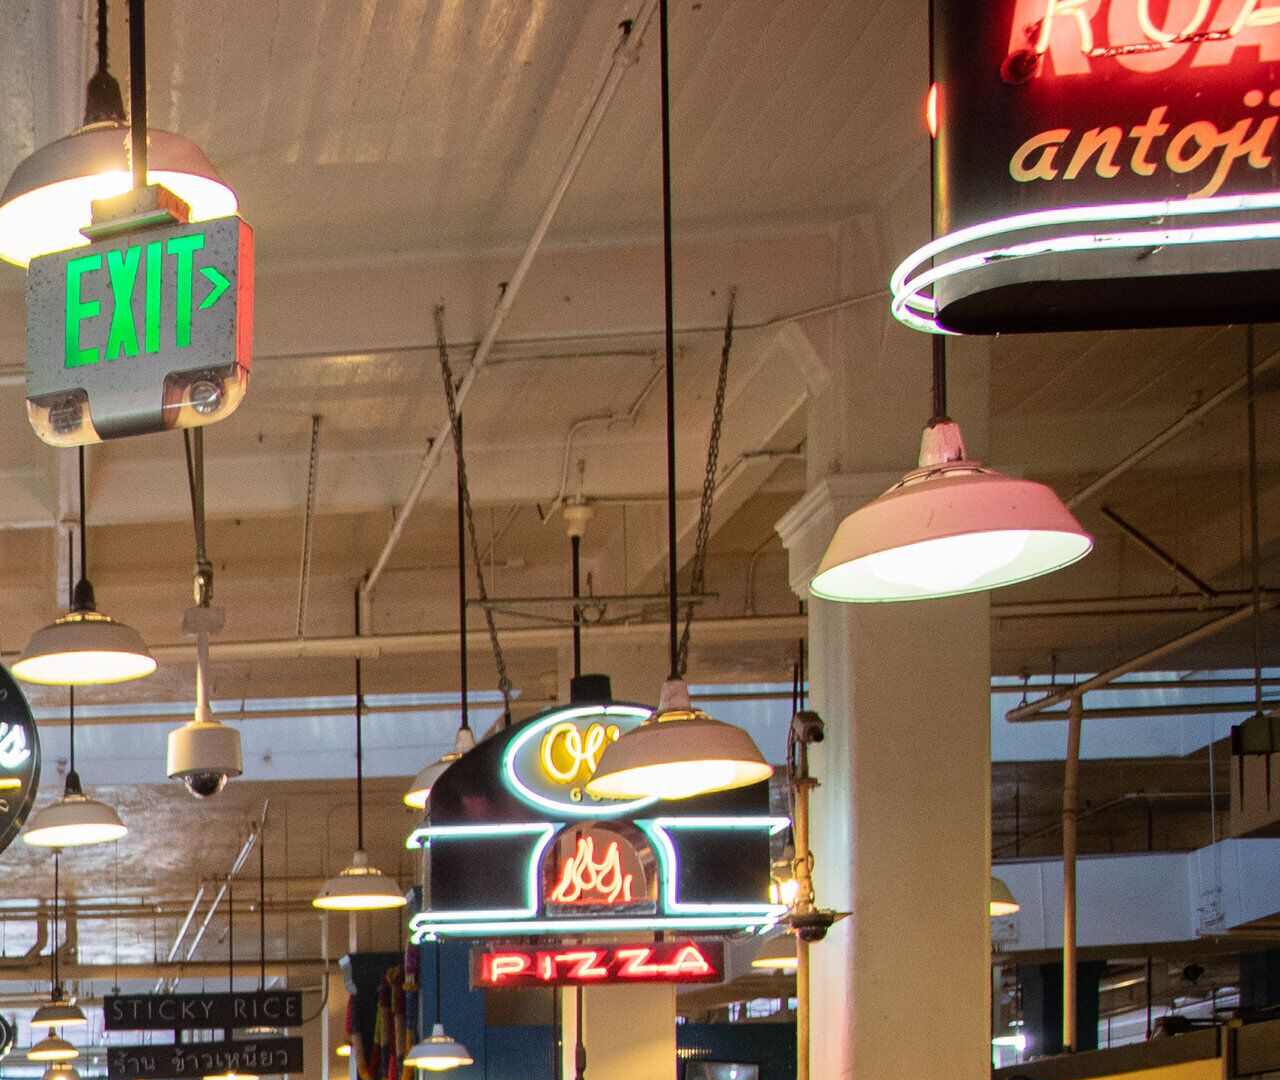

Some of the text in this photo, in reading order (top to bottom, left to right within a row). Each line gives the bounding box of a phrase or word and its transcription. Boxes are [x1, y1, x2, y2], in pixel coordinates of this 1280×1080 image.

[64, 233, 206, 369] EXIT
[483, 941, 714, 982] PIZZA
[112, 996, 297, 1022] STICKY RICE
